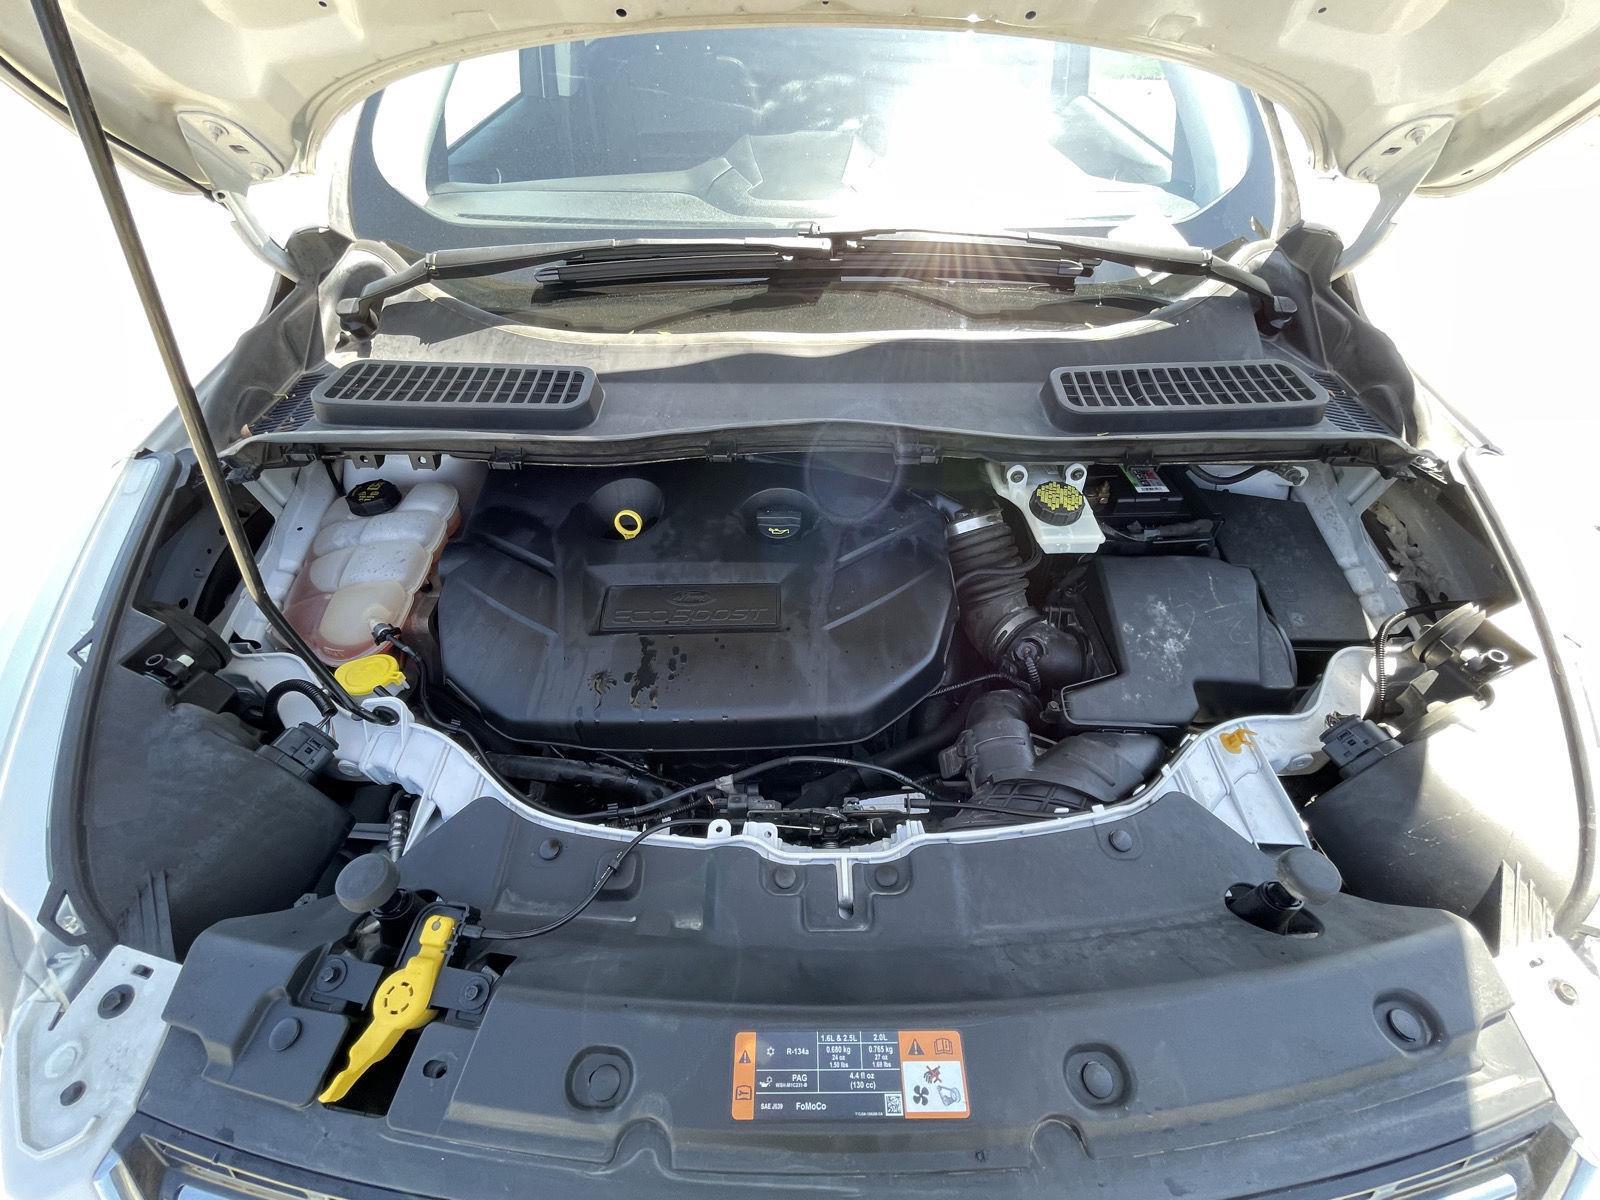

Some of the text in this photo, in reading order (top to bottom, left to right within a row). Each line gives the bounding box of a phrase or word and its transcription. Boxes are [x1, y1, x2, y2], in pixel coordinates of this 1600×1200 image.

[820, 1034, 858, 1042] 1.6L & 2.5L
[873, 1033, 888, 1041] 2.0L
[786, 1047, 810, 1055] R-134a
[826, 1046, 851, 1055] 0.680 kg
[868, 1045, 893, 1054] 0.765 kg
[792, 1074, 808, 1082] PAG
[860, 1071, 866, 1079] fl
[850, 1081, 876, 1090] (130 cc)
[760, 1102, 771, 1110] SAE
[795, 1102, 827, 1110] FoMoCo
